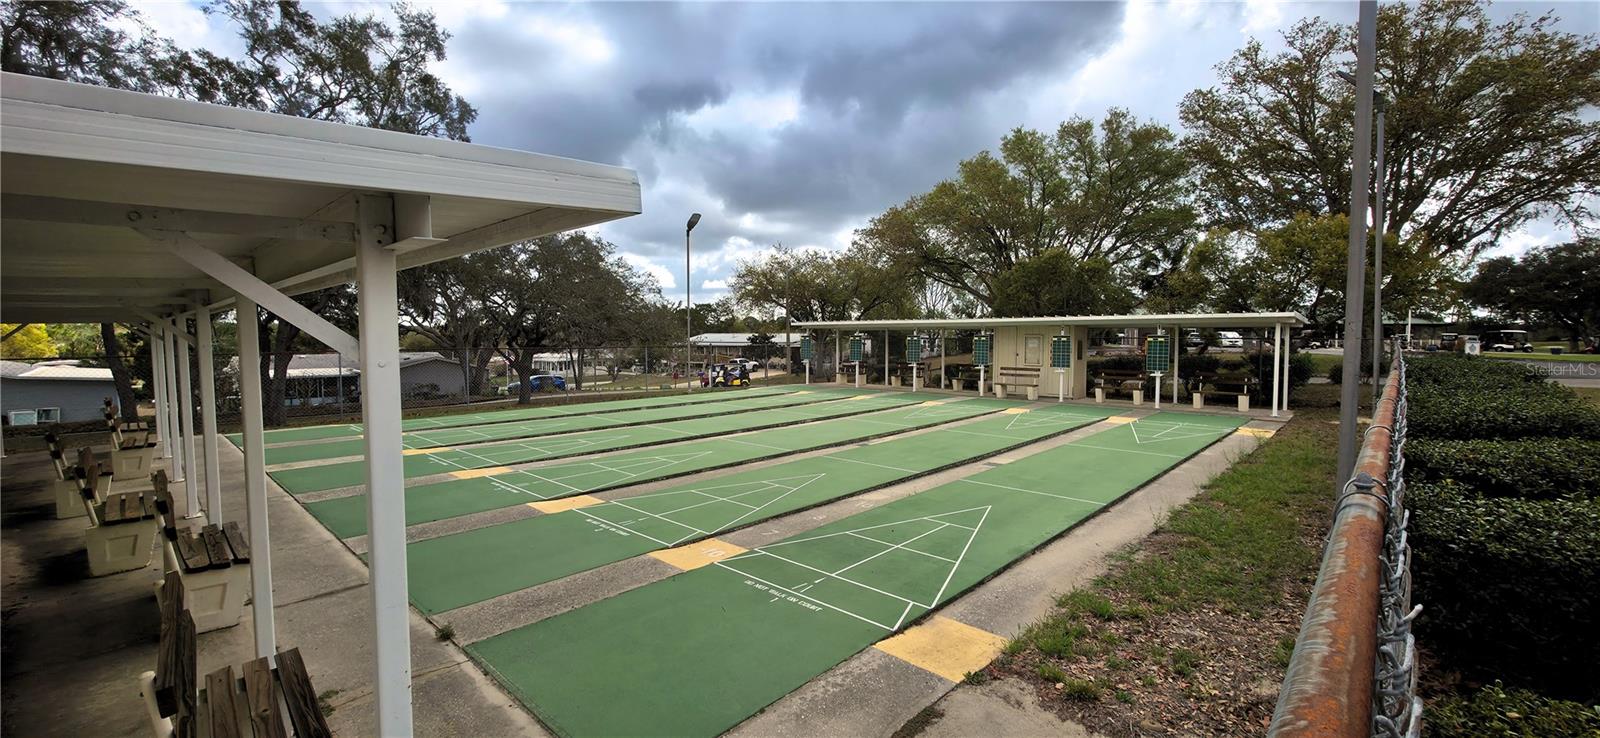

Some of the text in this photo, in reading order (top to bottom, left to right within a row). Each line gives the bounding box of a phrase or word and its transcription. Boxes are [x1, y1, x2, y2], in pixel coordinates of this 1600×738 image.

[753, 583, 770, 591] NOT
[768, 588, 787, 599] WALK
[798, 600, 823, 612] COURT
